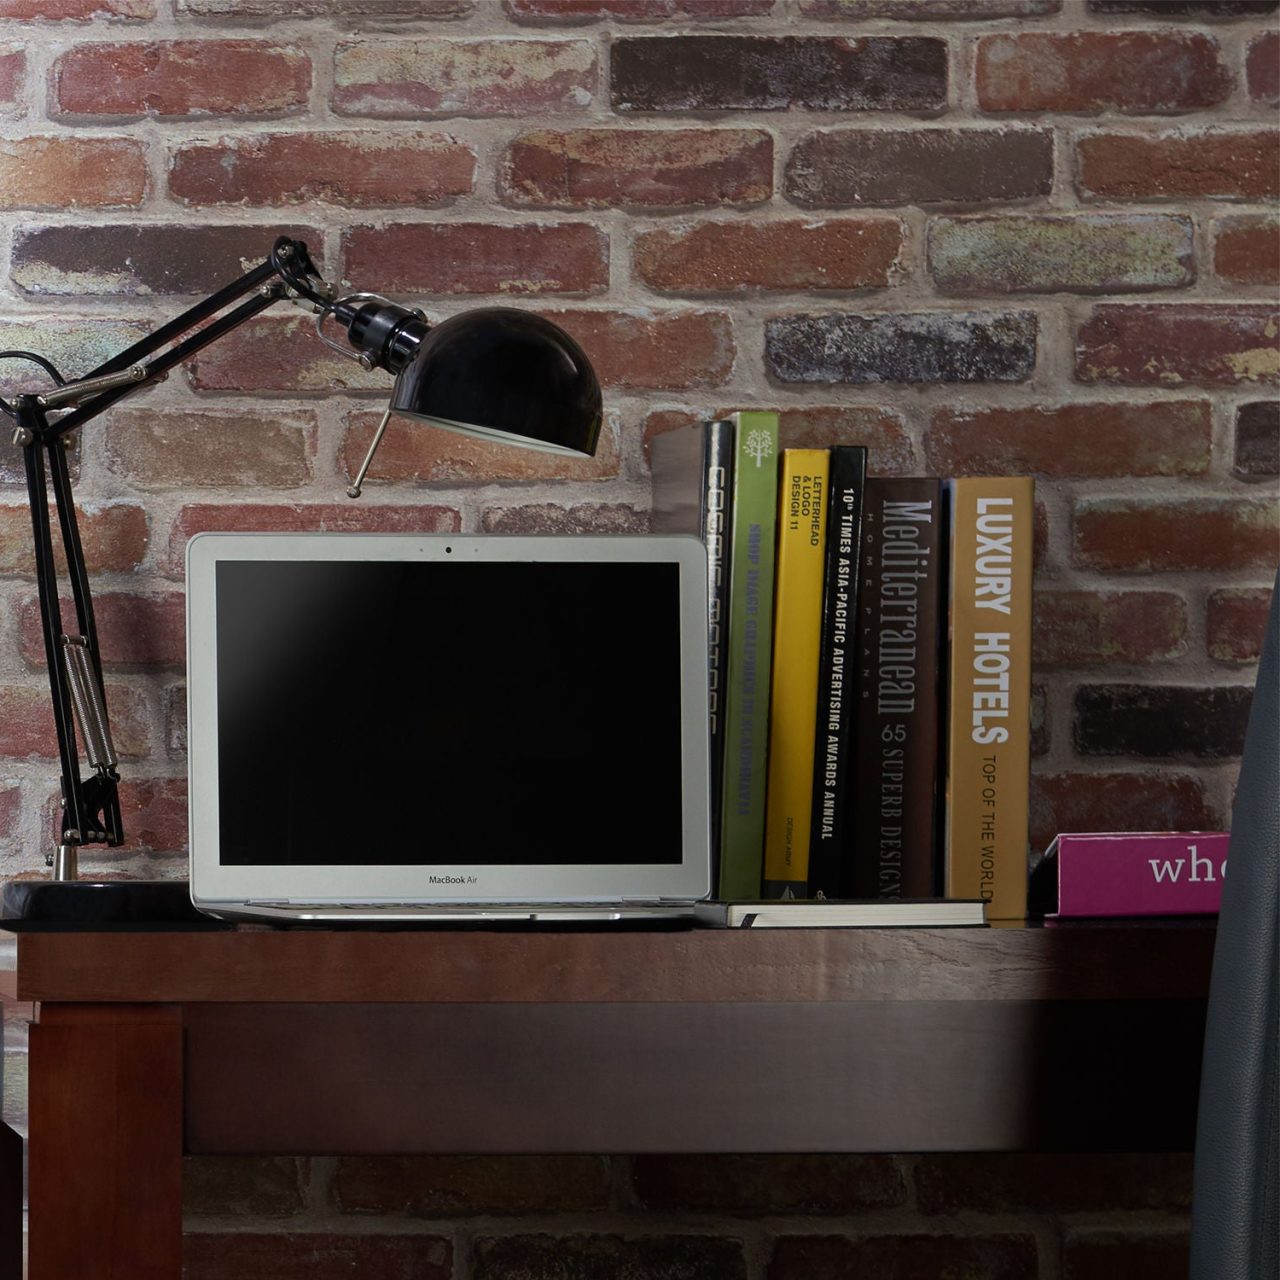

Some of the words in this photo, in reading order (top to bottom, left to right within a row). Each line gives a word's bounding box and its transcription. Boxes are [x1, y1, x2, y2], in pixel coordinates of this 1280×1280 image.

[791, 475, 801, 517] DESIGN
[801, 485, 811, 517] LOGO
[802, 475, 812, 483] &
[790, 521, 798, 531] 11
[810, 475, 822, 546] LETTERHEAD
[838, 514, 853, 554] TIMES
[865, 513, 874, 586] HOME
[974, 498, 1013, 615] LUXURY
[834, 558, 850, 643] ASIA-PACIFIC
[878, 500, 932, 715] Mediterranean
[862, 607, 872, 698] PLANS
[828, 648, 844, 731] ADVERTISING
[971, 632, 1011, 745] HOTELS
[881, 724, 907, 742] 65
[824, 735, 839, 787] AWARDS
[880, 748, 904, 818] SUPERB
[982, 755, 996, 784] TOP
[821, 791, 835, 840] ANNUAL
[981, 788, 996, 807] OF
[981, 814, 995, 840] THE
[429, 875, 465, 884] MacBook
[467, 875, 478, 884] Air
[879, 827, 902, 899] DESIGN
[979, 845, 994, 904] WORLD
